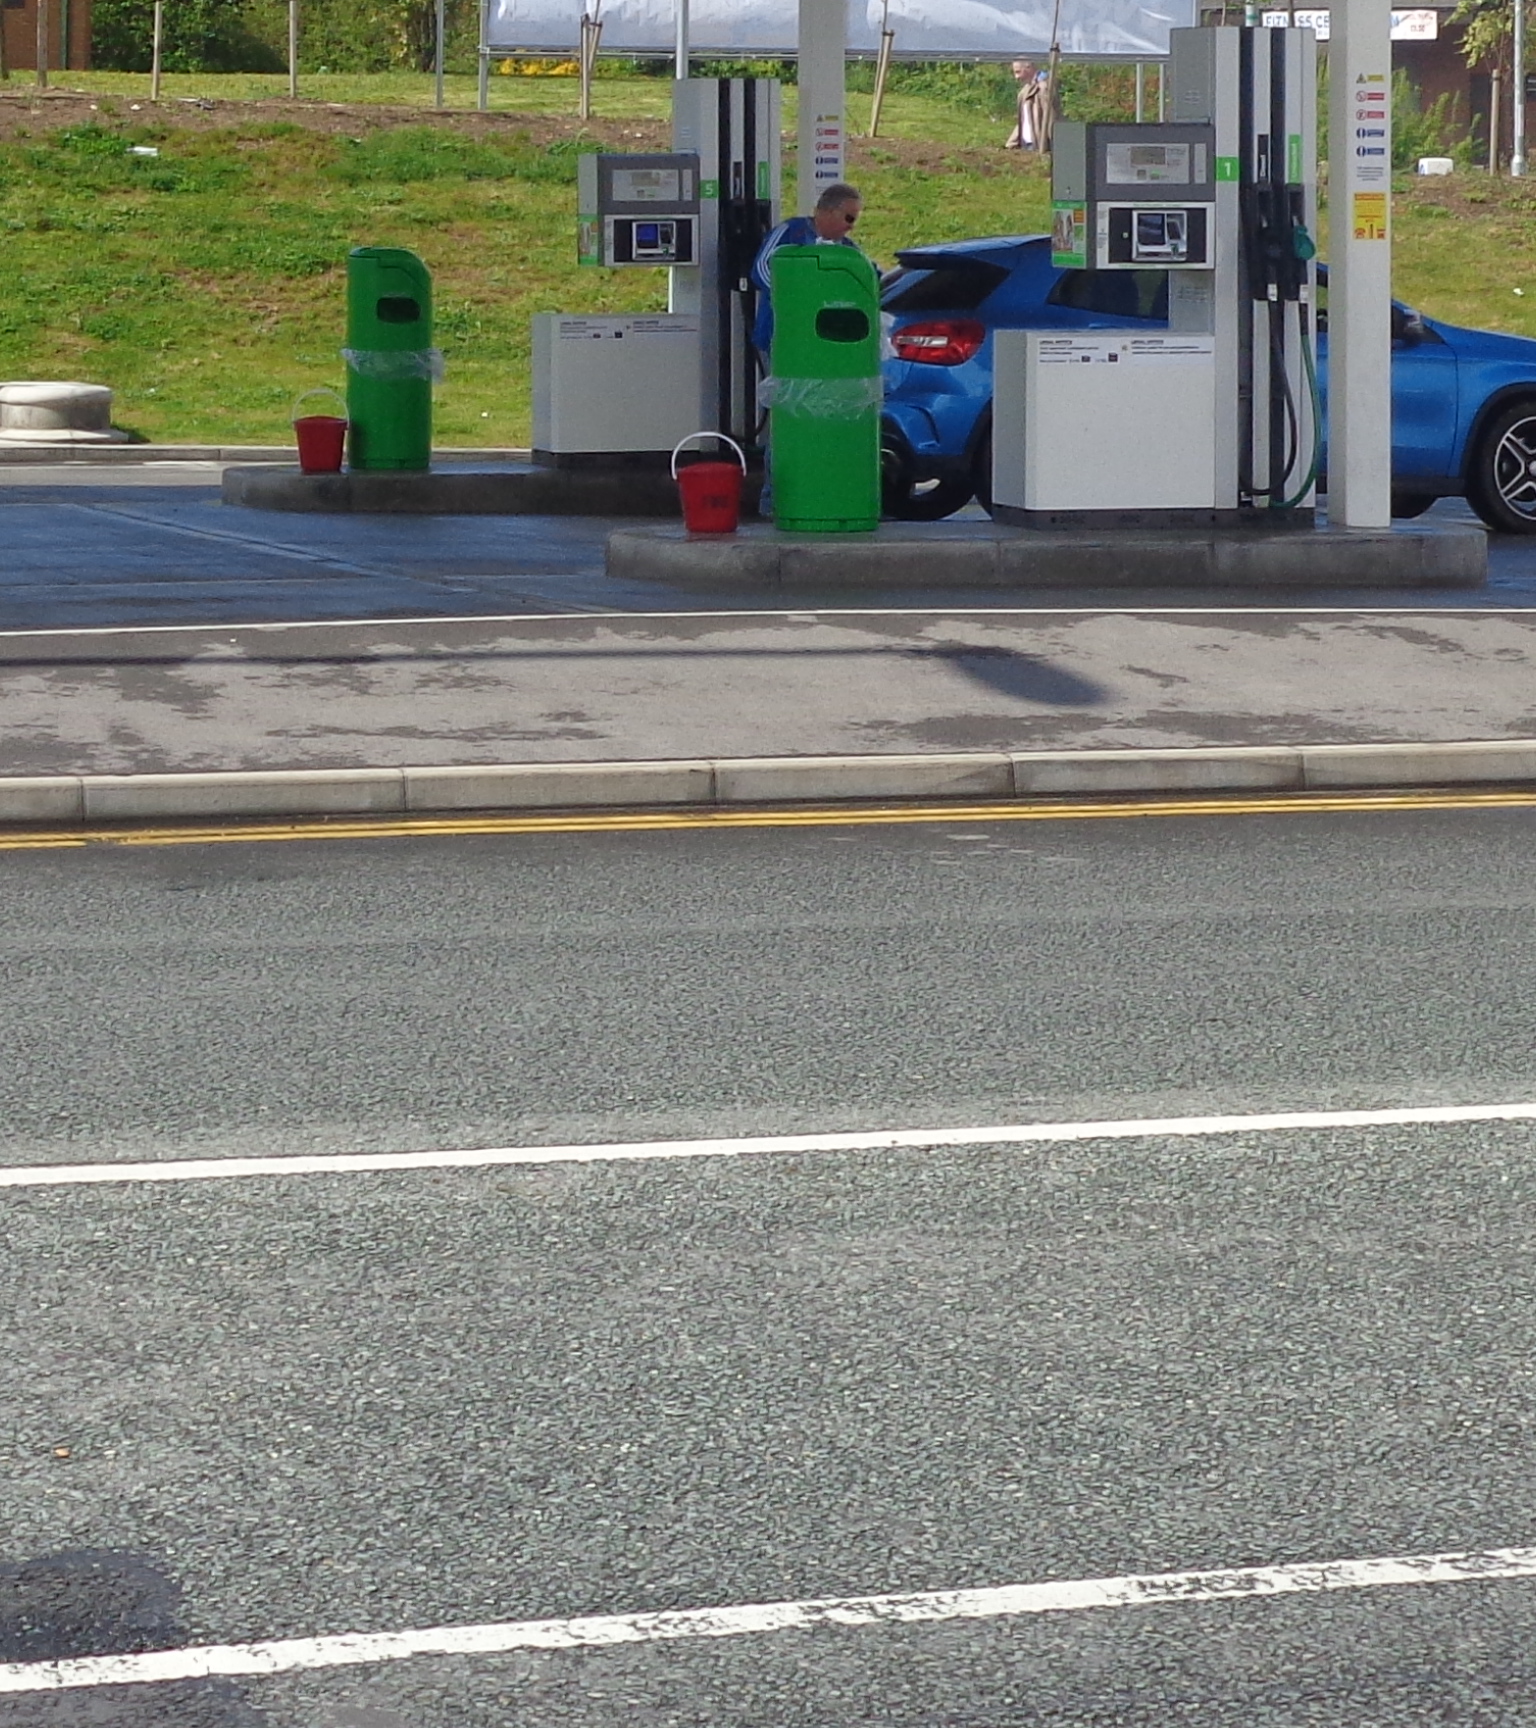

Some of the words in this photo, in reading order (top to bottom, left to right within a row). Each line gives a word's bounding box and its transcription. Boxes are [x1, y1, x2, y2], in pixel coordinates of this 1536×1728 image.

[1266, 15, 1313, 28] FITNSS
[1224, 162, 1231, 177] 1
[705, 183, 713, 195] 5
